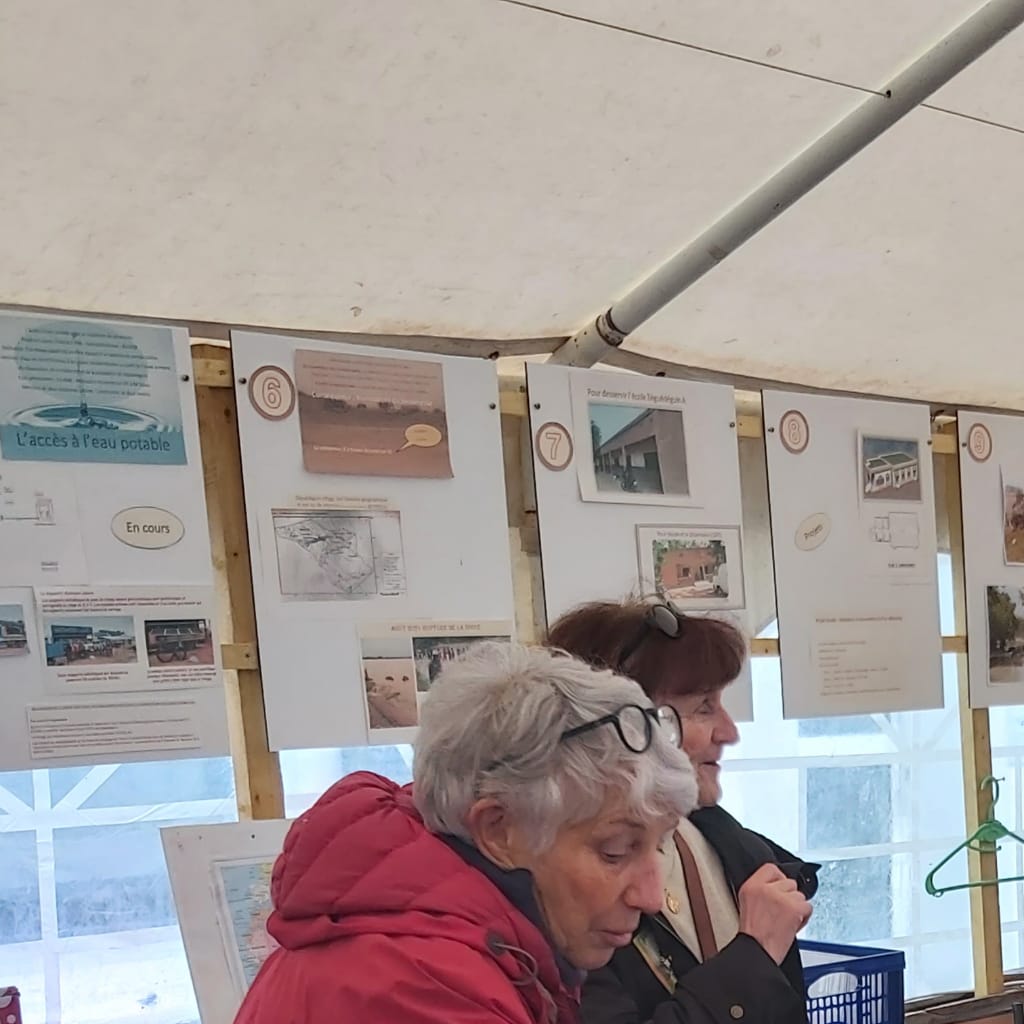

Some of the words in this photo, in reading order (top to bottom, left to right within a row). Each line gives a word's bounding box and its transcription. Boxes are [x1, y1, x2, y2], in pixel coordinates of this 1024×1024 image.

[261, 376, 282, 410] 6
[16, 431, 68, 447] L'accès
[72, 433, 80, 448] à
[83, 432, 116, 449] l'eau
[121, 435, 171, 451] potable
[787, 418, 802, 445] 8
[973, 429, 986, 455] 9
[545, 432, 562, 461] 7
[126, 521, 140, 533] En
[142, 524, 170, 534] cours
